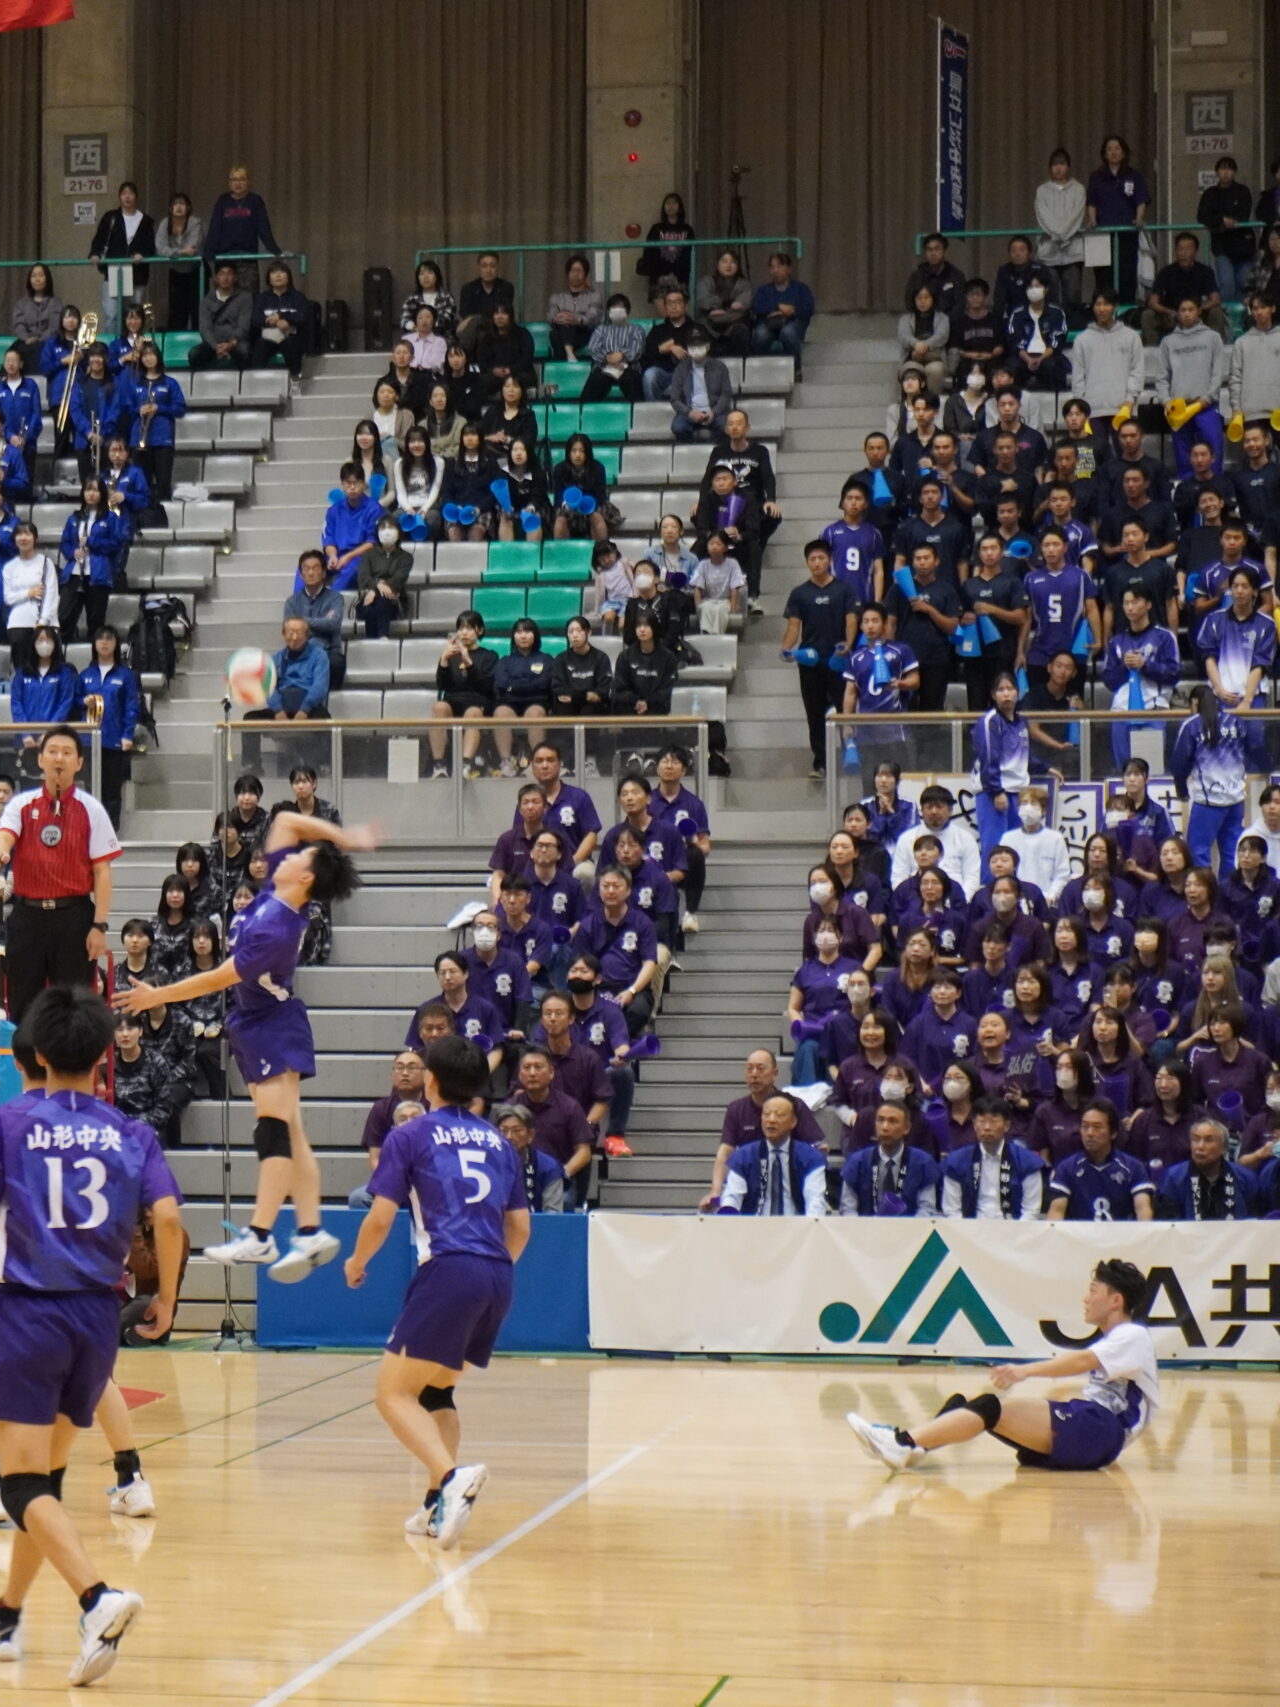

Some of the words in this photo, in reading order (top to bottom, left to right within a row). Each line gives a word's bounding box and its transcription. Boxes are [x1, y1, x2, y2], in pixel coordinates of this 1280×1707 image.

[846, 547, 860, 571] 9
[1048, 594, 1062, 618] 5
[26, 1123, 122, 1152] 山形中央
[431, 1125, 502, 1152] 山形中央
[457, 1149, 492, 1205] 5
[43, 1156, 110, 1230] 13
